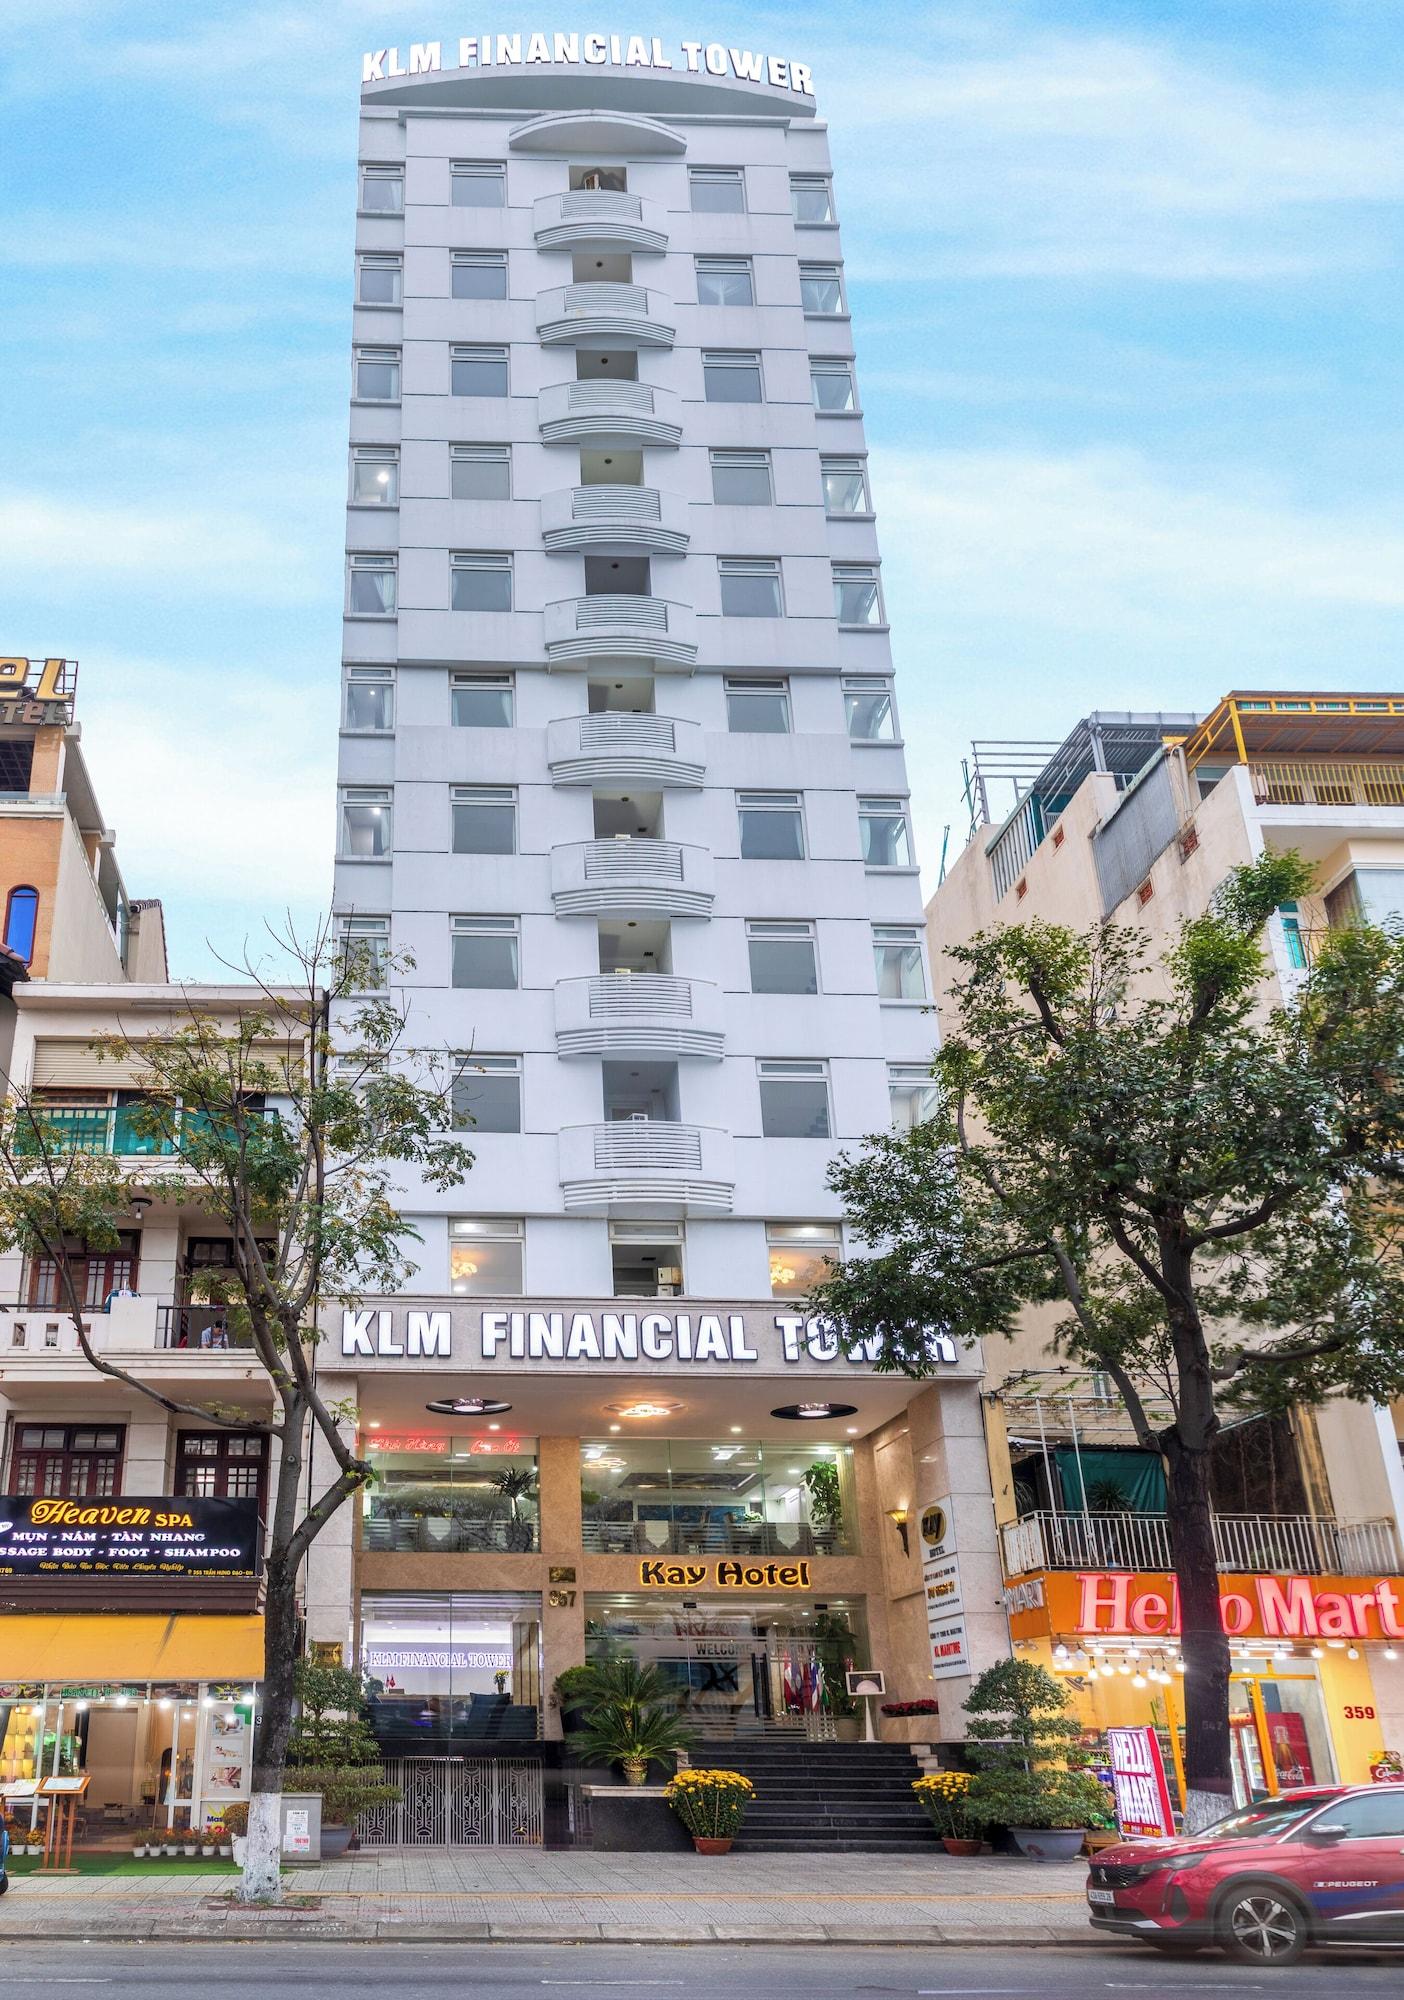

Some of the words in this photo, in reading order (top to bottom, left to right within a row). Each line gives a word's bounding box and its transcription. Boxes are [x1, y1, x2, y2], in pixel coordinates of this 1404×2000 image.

[361, 41, 441, 83] KLM
[458, 32, 673, 69] FINANCIAL
[681, 41, 815, 95] TOWER
[341, 1310, 451, 1358] KLM
[481, 1312, 758, 1361] FINANCIAL
[774, 1316, 959, 1362] TOWR
[31, 1499, 151, 1524] Heaven
[154, 1513, 193, 1527] SPA
[12, 1532, 48, 1543] MỤN
[62, 1531, 97, 1541] NÁM
[111, 1531, 144, 1542] TÀN
[150, 1533, 206, 1542] NHANG
[52, 1547, 95, 1557] BODY
[108, 1548, 150, 1557] FOOT
[164, 1548, 241, 1557] SHAMPOO
[640, 1561, 707, 1587] Kay
[716, 1561, 811, 1587] Hotel
[1074, 1573, 1254, 1635] Helo
[1255, 1576, 1404, 1637] Mart
[370, 1652, 399, 1667] KLM
[400, 1652, 467, 1667] FINANCIAL
[469, 1653, 513, 1668] TOWER
[1344, 1706, 1375, 1720] 359
[1117, 1775, 1160, 1825] MART
[1328, 1880, 1378, 1888] PEUGEOT
